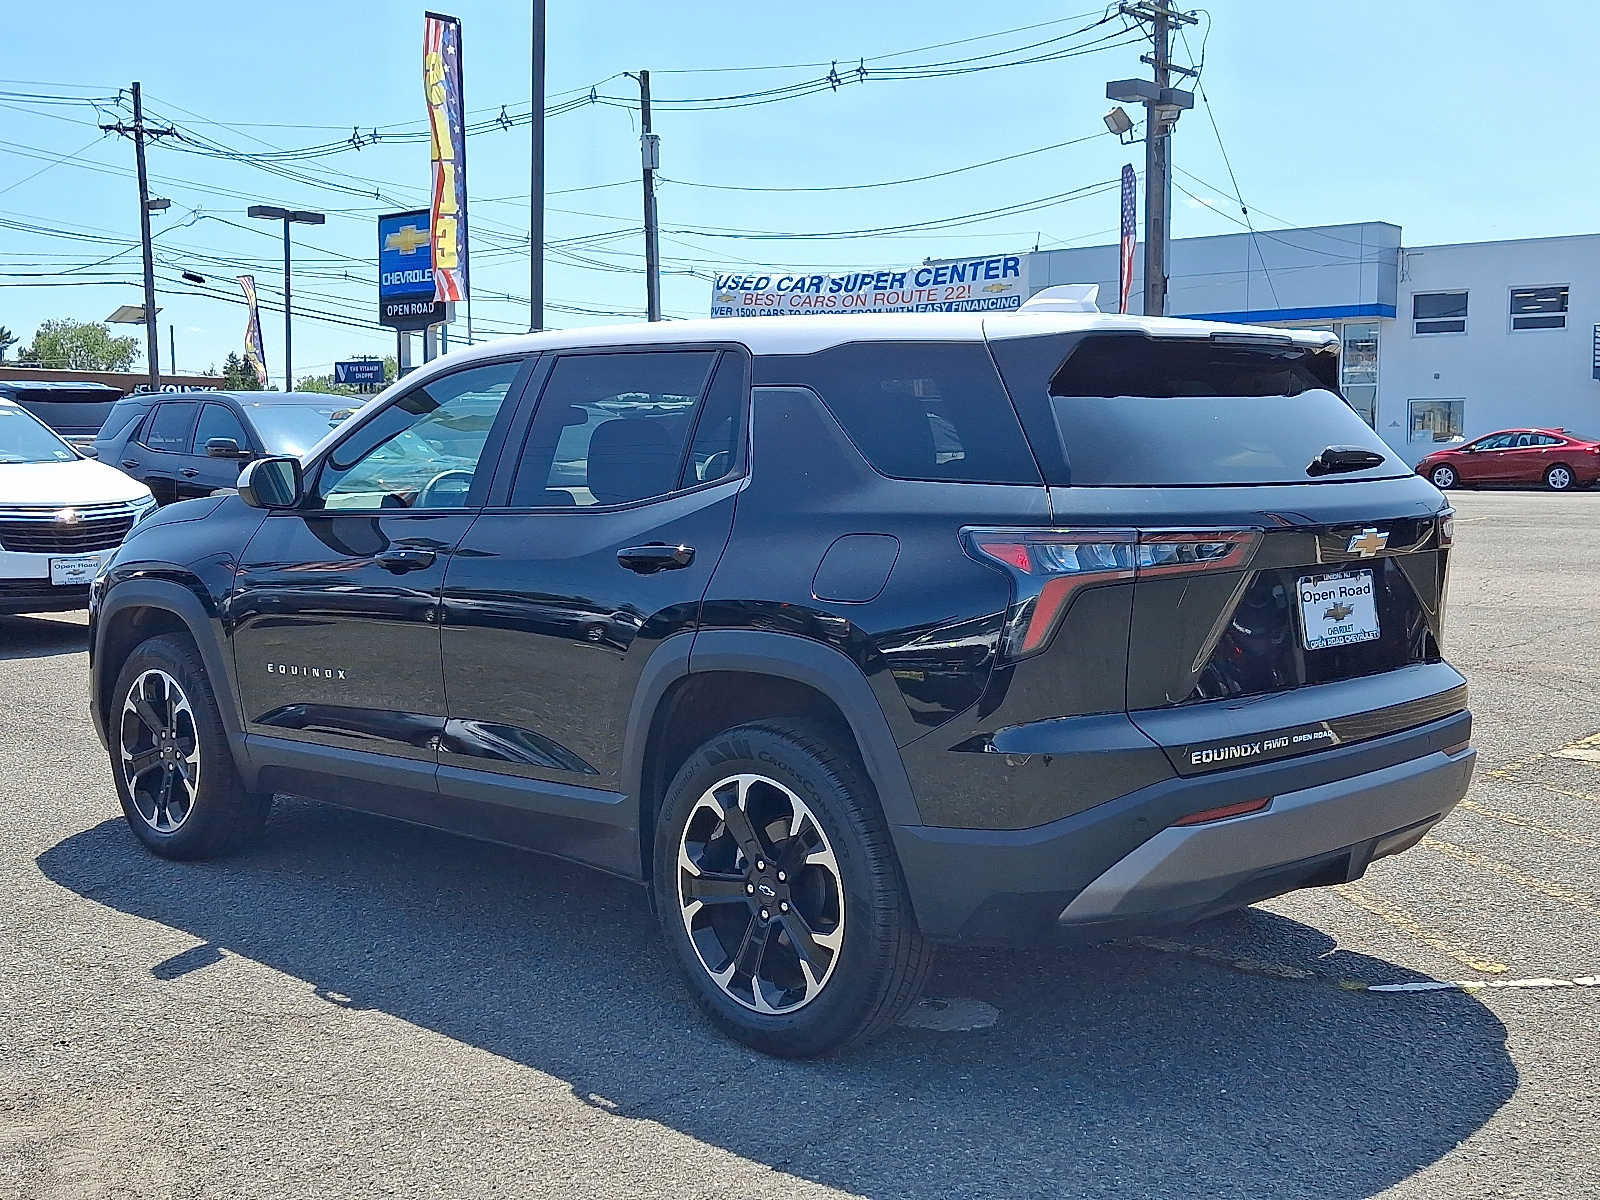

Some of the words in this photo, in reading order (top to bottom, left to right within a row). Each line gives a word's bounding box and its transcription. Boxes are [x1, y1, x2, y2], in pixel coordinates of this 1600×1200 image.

[382, 268, 434, 286] CHEVROLE
[716, 274, 771, 291] USED
[776, 276, 824, 293] CAR
[828, 272, 907, 294] SUPER
[914, 257, 1020, 288] CENTER
[743, 293, 786, 306] BEST
[789, 295, 837, 307] CARS
[842, 294, 868, 308] ON
[874, 288, 938, 306] ROUTE
[944, 285, 972, 301] 22!
[387, 304, 410, 316] OPEN
[411, 302, 435, 314] ROAD
[735, 308, 757, 317] 1500
[917, 302, 950, 312] EASY
[950, 297, 1019, 312] FINANCING
[1302, 589, 1336, 604] Open
[1338, 583, 1371, 598] Road
[1310, 639, 1326, 649] OPEN
[1327, 636, 1345, 645] ROAD
[1345, 631, 1379, 642] CHEVROLET
[267, 663, 346, 680] EQUINOX
[1191, 742, 1261, 765] EQUINOX
[1263, 736, 1289, 751] AWD
[1292, 734, 1313, 743] OPEN
[1313, 730, 1333, 740] ROAD
